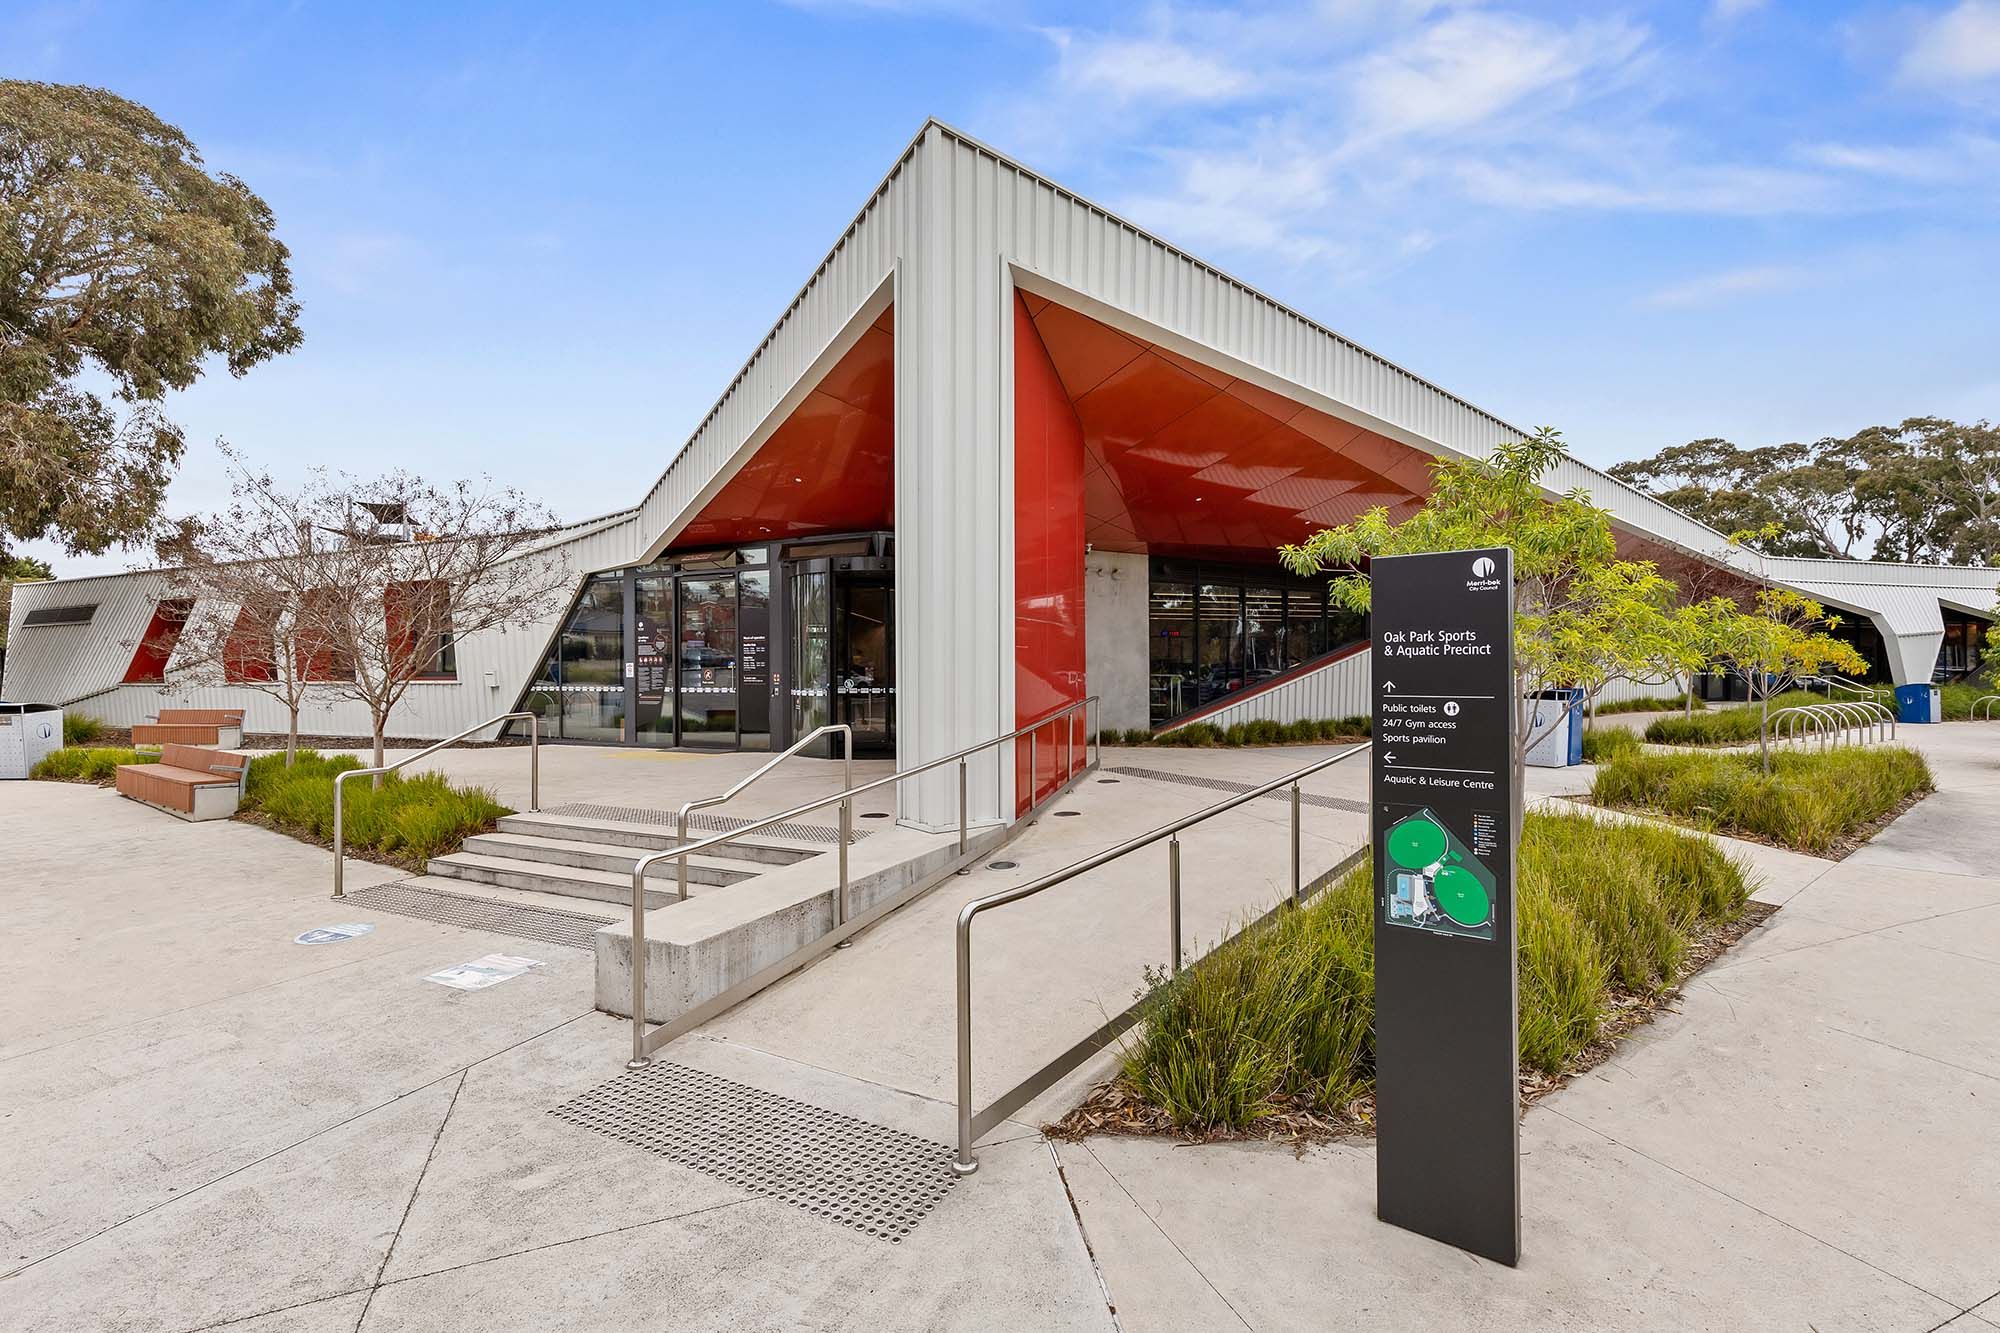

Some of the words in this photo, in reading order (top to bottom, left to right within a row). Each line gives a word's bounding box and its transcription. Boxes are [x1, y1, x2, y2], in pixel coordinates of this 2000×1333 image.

[1466, 579, 1501, 587] Merri-bek
[1383, 631, 1406, 643] Oak
[1409, 630, 1435, 642] Park
[1438, 630, 1476, 644] Sports
[1383, 645, 1393, 656] &
[1396, 644, 1440, 659] Aquatic
[1443, 643, 1492, 655] Precinct
[1382, 703, 1408, 713] Public
[1410, 704, 1437, 714] toilets
[1382, 718, 1402, 727] 24/7
[1405, 719, 1426, 730] Gym
[1428, 721, 1457, 729] access
[1382, 733, 1410, 744] Sports
[1412, 734, 1446, 745] pavilion
[1383, 774, 1417, 785] Aquatic
[1419, 776, 1427, 785] &
[1429, 777, 1460, 788] Leisure
[1462, 779, 1495, 790] Centre
